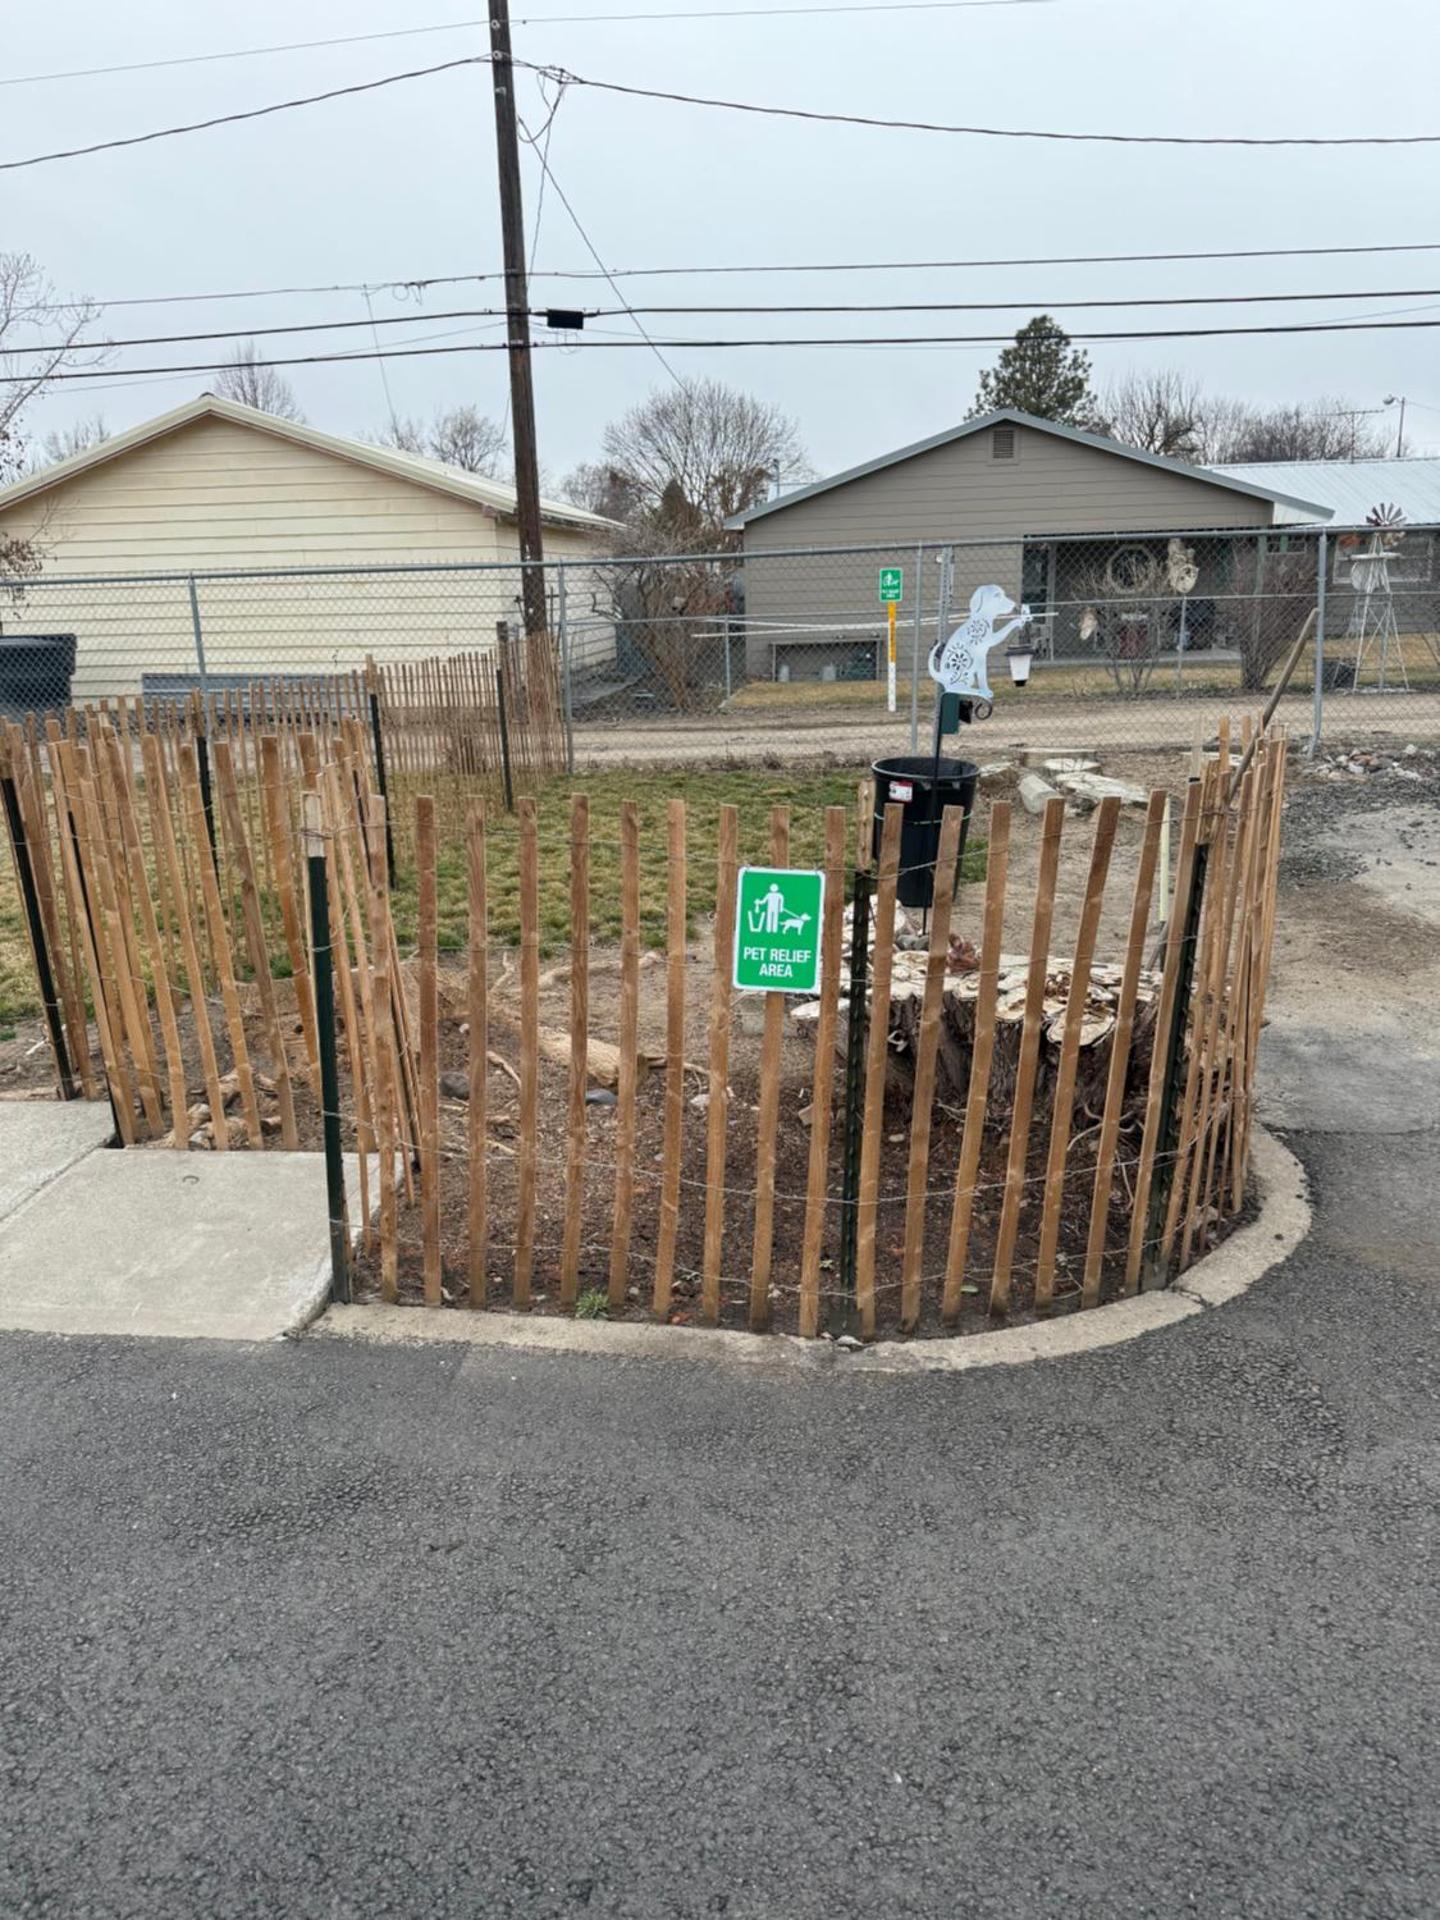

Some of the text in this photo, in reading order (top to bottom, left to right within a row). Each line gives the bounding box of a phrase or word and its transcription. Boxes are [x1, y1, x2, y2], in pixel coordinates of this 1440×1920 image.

[743, 946, 812, 962] PET RELIEF
[759, 963, 793, 977] AREA
